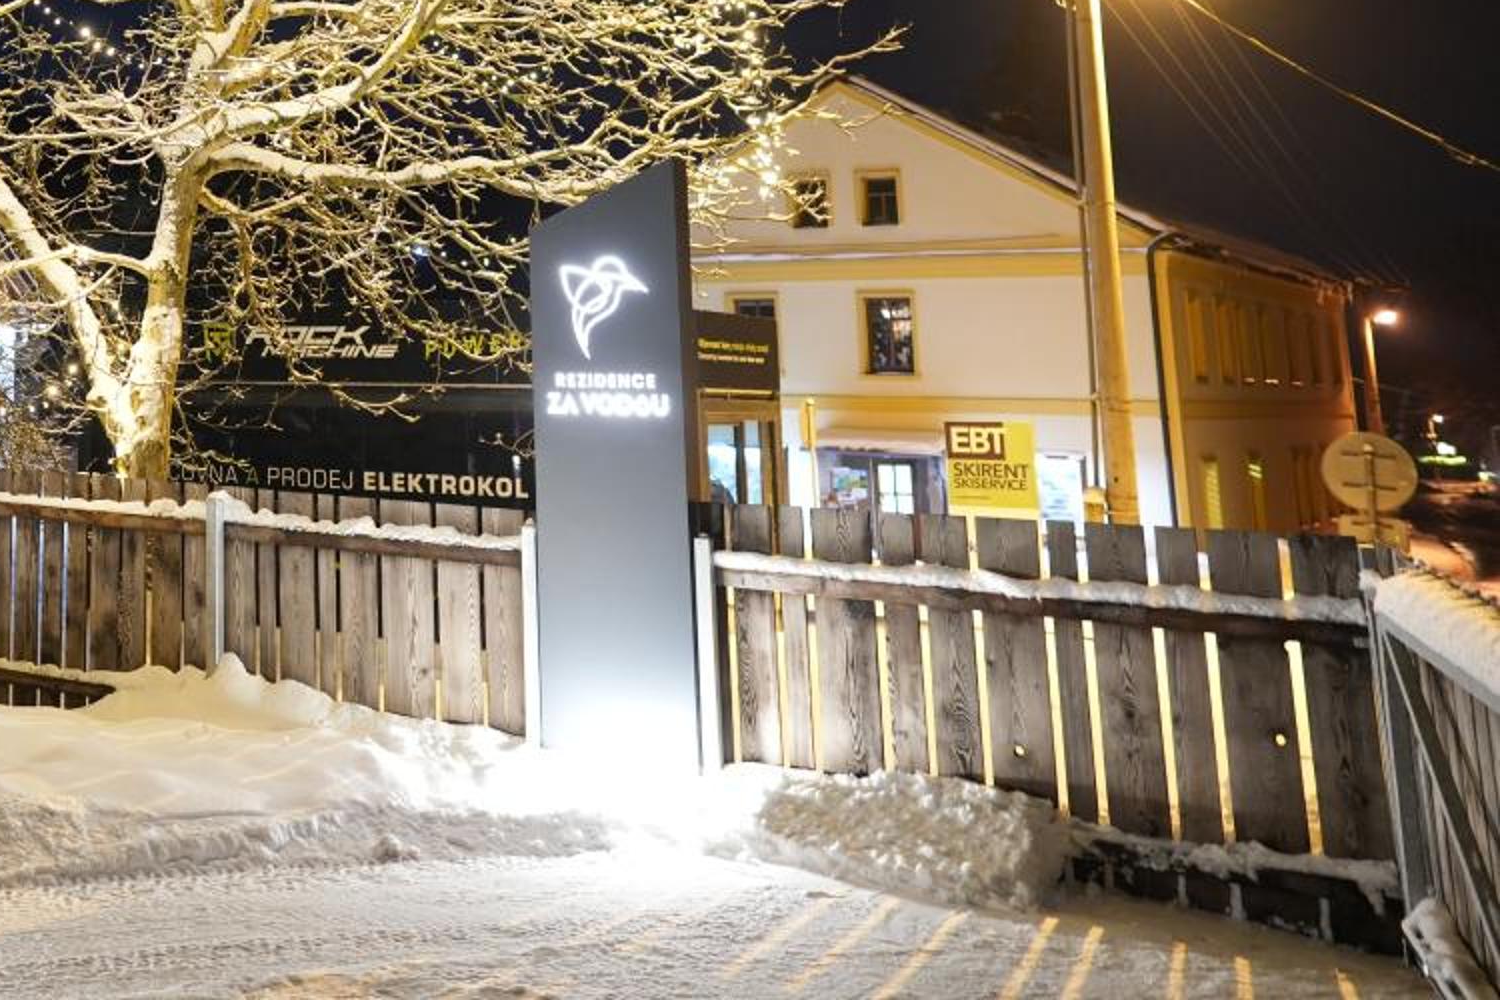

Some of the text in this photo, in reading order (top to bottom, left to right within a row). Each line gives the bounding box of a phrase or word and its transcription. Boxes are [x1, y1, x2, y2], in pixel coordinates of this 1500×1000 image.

[246, 325, 371, 346] ROCK
[553, 371, 657, 390] REZIDENCE
[546, 391, 670, 419] ZA VODOU
[949, 426, 1008, 455] EBT
[953, 461, 1028, 479] SKIRENT
[266, 466, 354, 490] PRODEJ
[362, 470, 530, 499] ELEKTROKOL
[953, 478, 1028, 491] SKISERVICE
